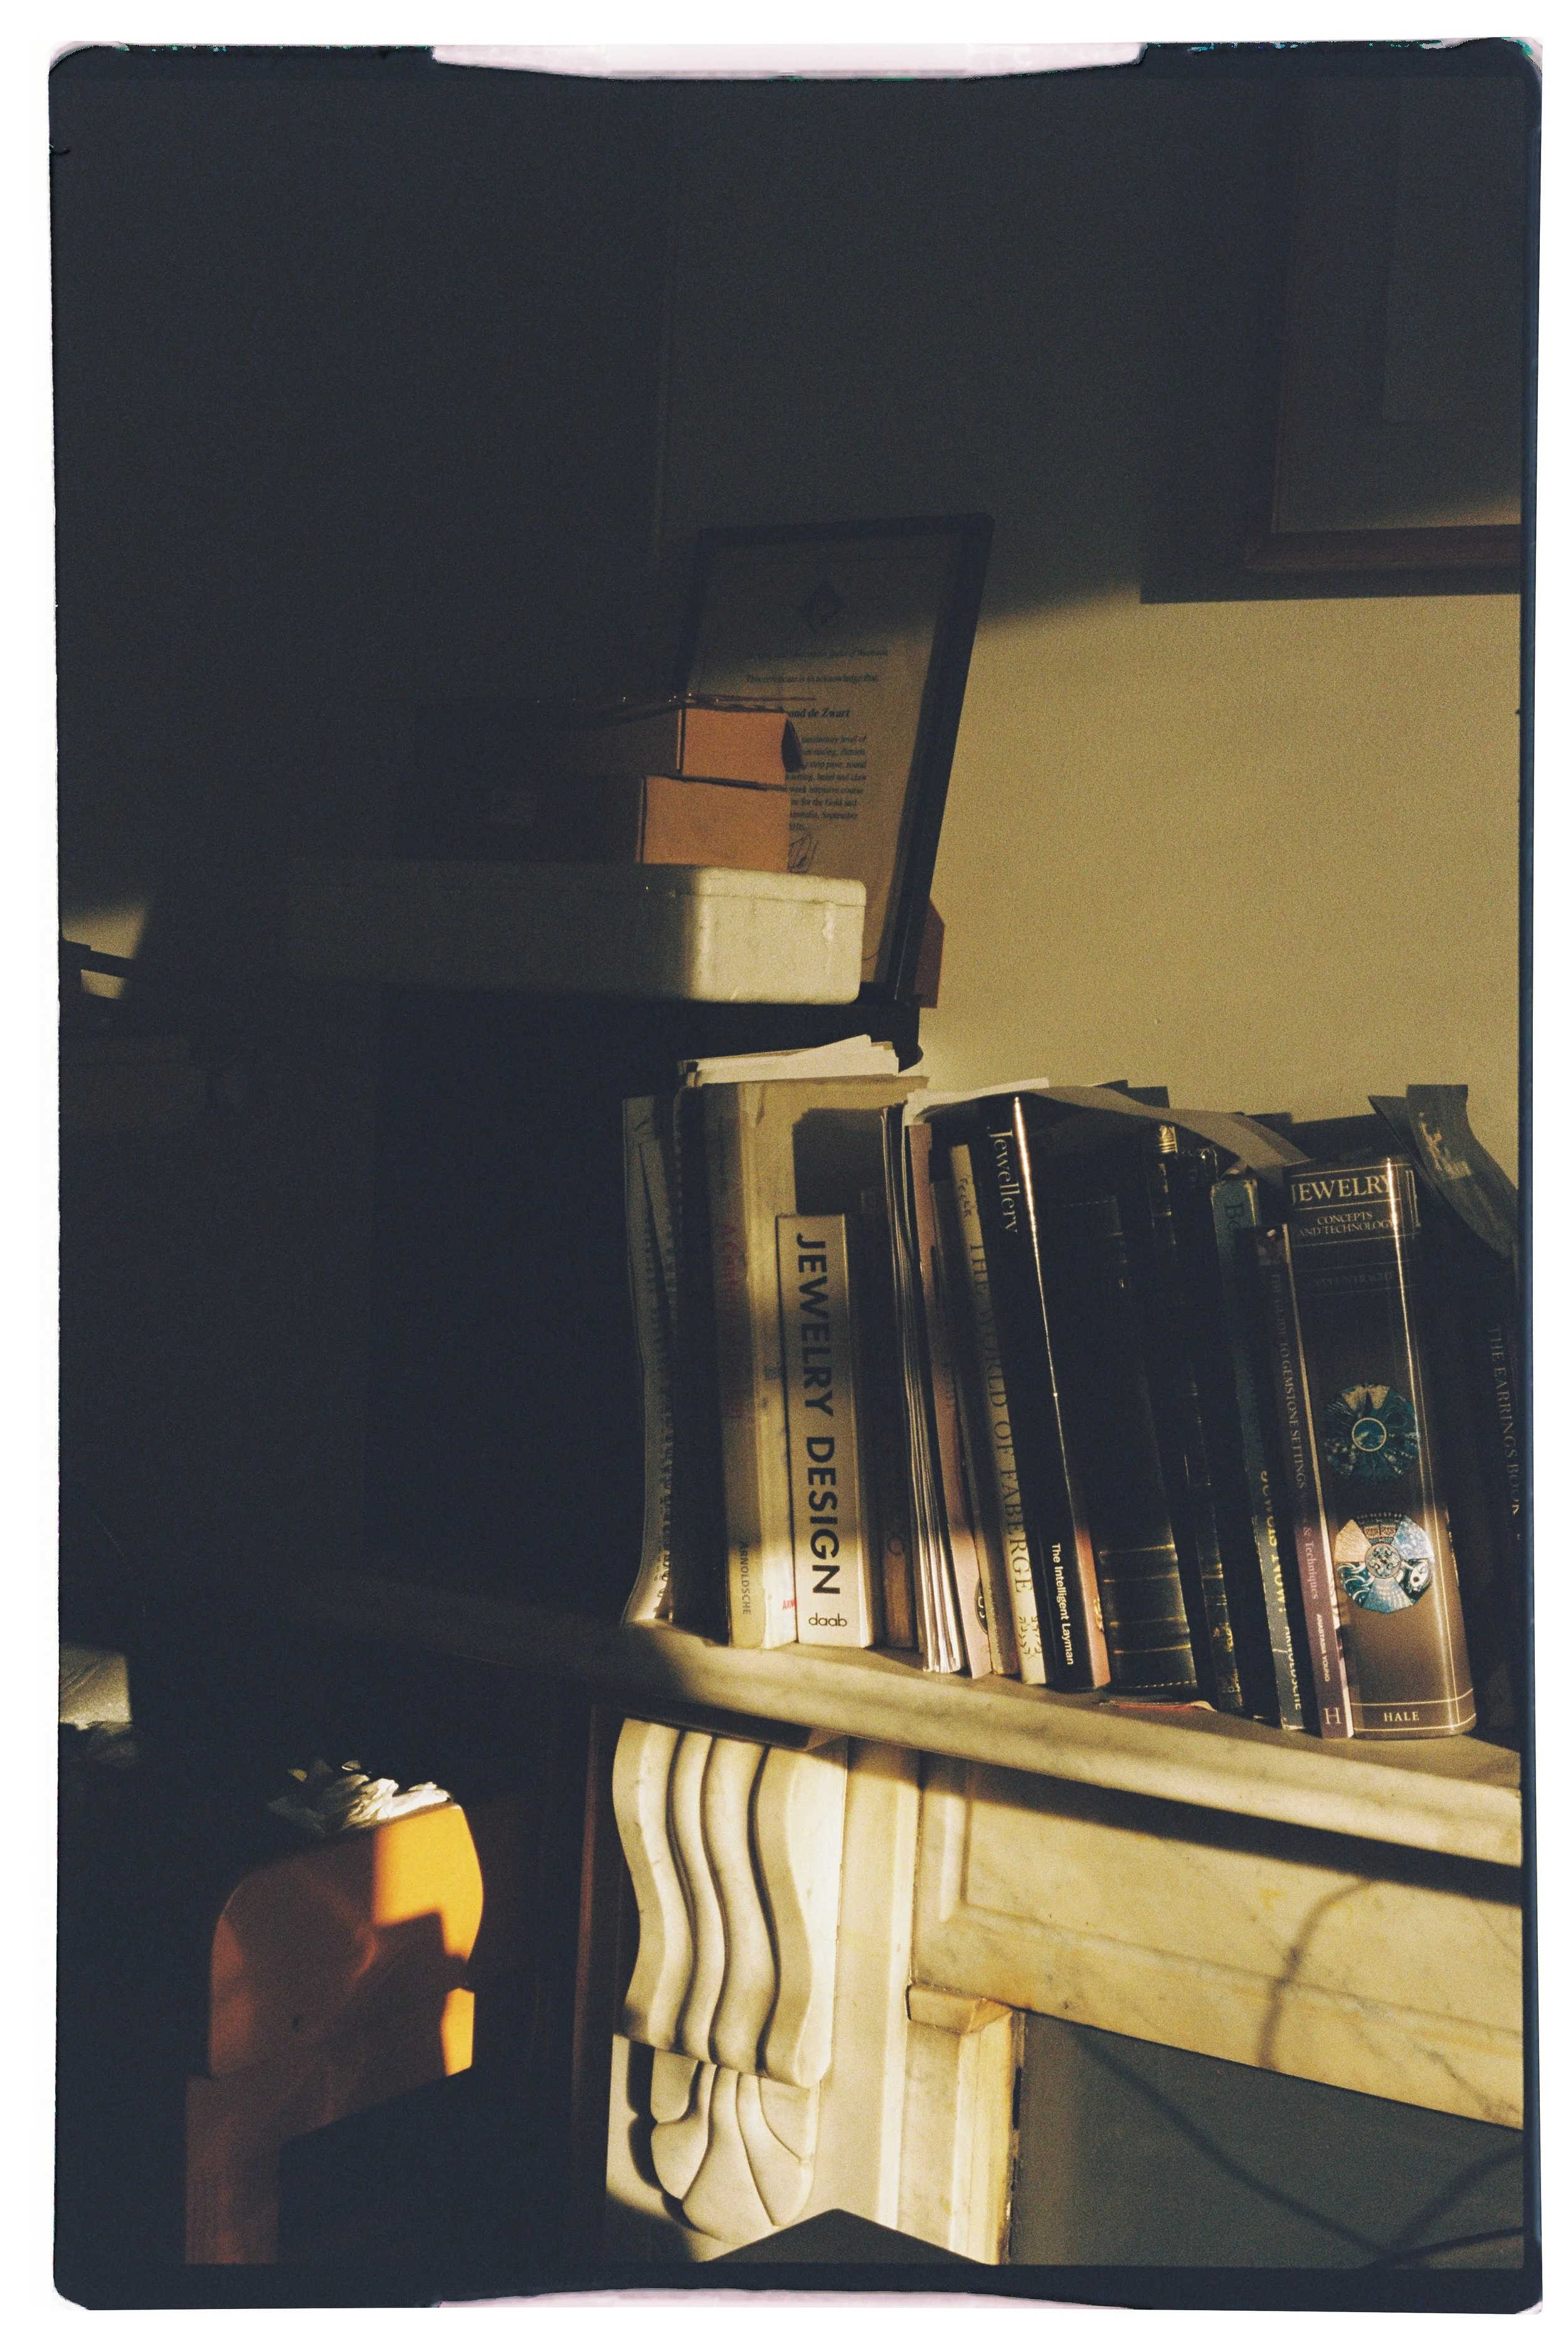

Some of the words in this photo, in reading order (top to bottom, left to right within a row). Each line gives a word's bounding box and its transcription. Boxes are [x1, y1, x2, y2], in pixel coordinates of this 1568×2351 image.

[808, 708, 819, 718] de
[821, 708, 850, 718] Zwart
[986, 1126, 1020, 1234] Jewellery
[1290, 1174, 1392, 1206] JEWELRY
[1298, 1226, 1322, 1238] AND
[1316, 1211, 1372, 1226] CONCEPTS
[796, 1232, 835, 1417] JEWELRY
[1488, 1325, 1505, 1362] THE
[1280, 1359, 1298, 1428] GEMSTONE
[1290, 1430, 1307, 1489] SETTINGS
[1493, 1366, 1518, 1458] EARRINGS
[993, 1421, 1013, 1457] OF
[805, 1436, 841, 1595] DESIGN
[1051, 1542, 1061, 1563] The
[1303, 1541, 1320, 1600] Techniques
[739, 1540, 751, 1616] ARNOLDSCHE
[1054, 1565, 1069, 1620] Intelligent
[808, 1613, 848, 1627] daab
[1061, 1622, 1075, 1665] Layman
[1321, 1655, 1331, 1682] YOUNG
[1323, 1706, 1342, 1725] H
[1383, 1710, 1420, 1723] HALE
